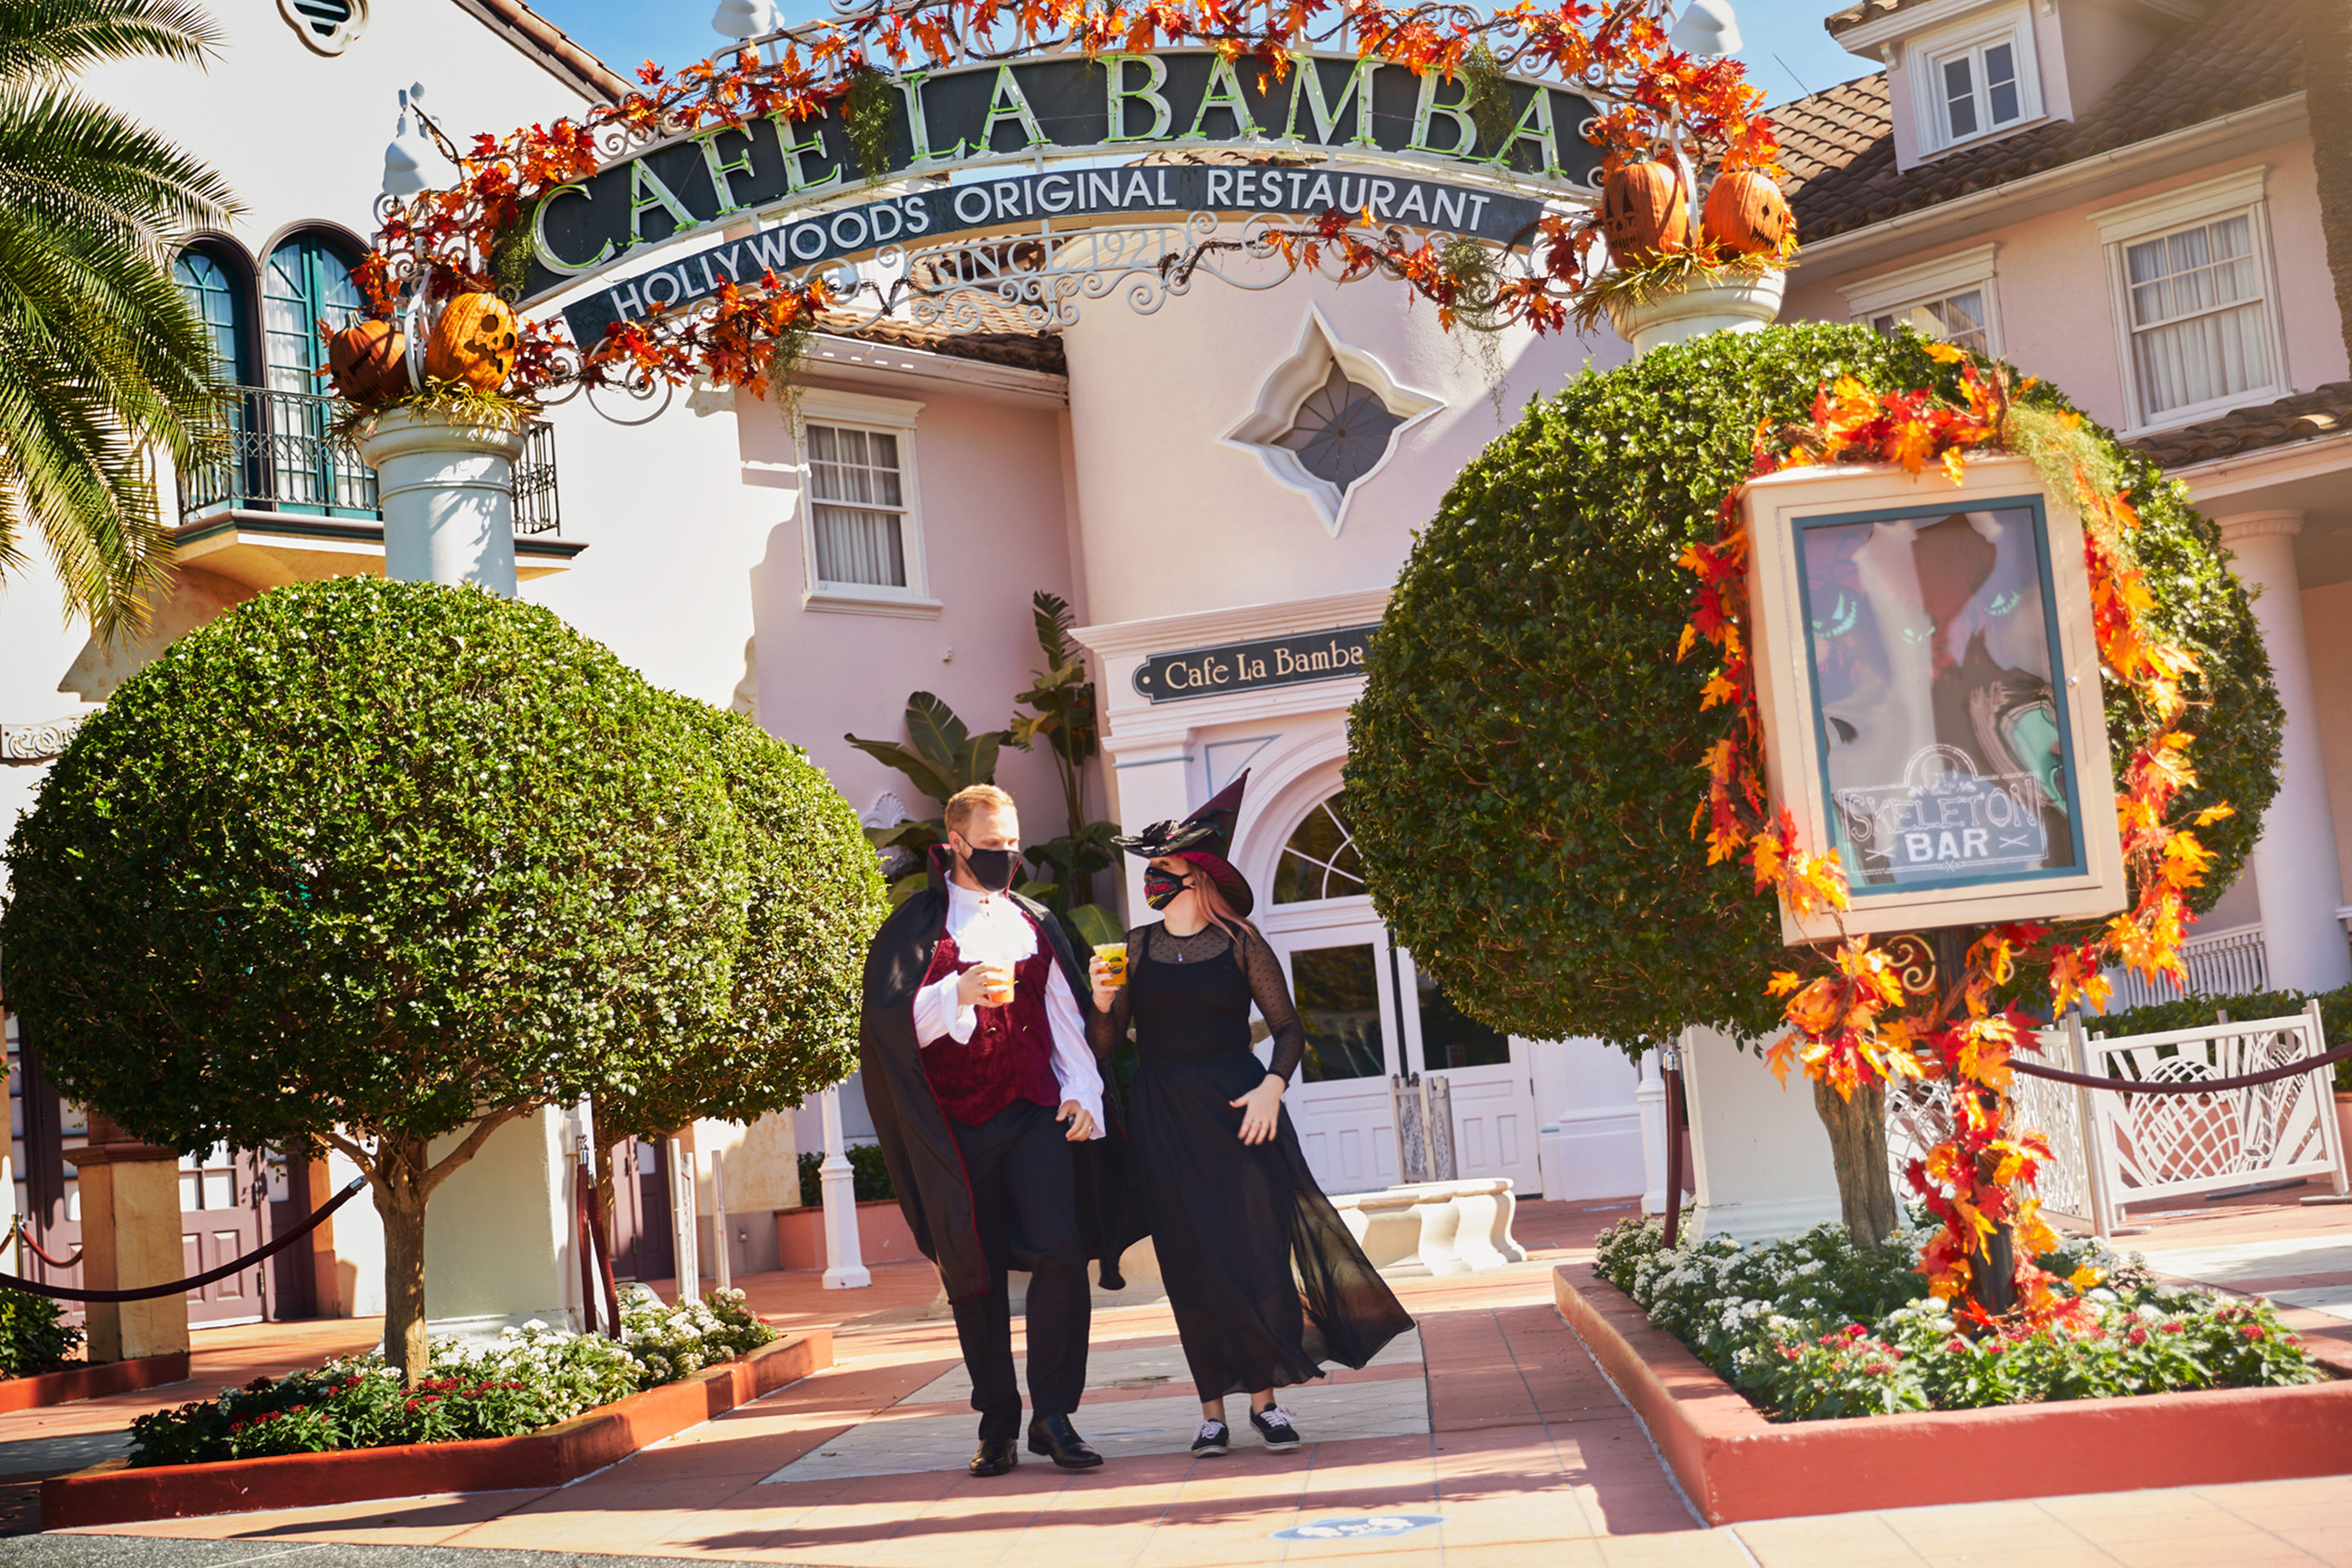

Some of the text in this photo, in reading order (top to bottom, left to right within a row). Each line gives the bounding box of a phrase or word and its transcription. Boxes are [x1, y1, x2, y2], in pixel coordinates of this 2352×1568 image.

[532, 51, 1573, 278] CAFE LA BAMBA
[610, 168, 1491, 323] HOLLYWOOD'S ORIGINAL RESTAURANT
[1165, 639, 1365, 689] Cafe La Bamba
[1848, 778, 2038, 842] SKELETON
[1904, 828, 1989, 862] BAR
